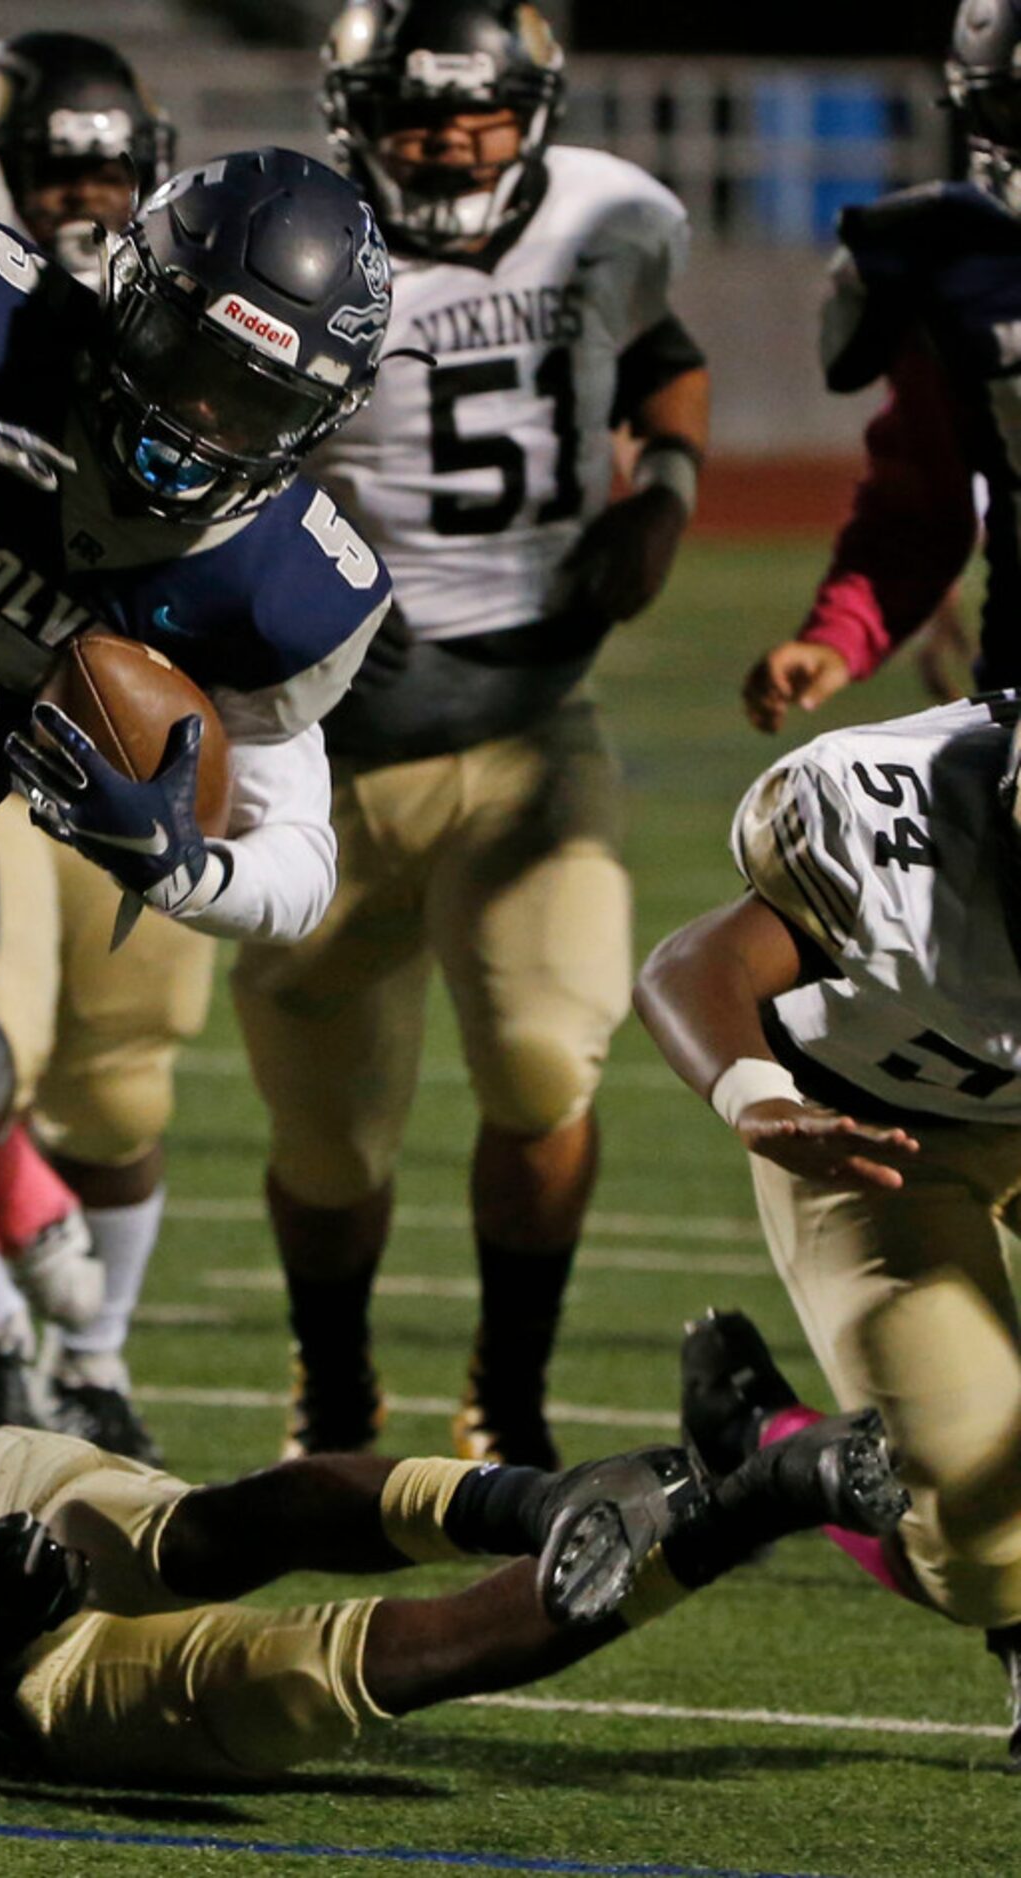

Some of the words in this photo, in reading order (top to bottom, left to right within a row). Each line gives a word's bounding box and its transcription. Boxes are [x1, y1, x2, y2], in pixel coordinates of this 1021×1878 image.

[224, 300, 293, 349] Riddell
[412, 285, 582, 353] VIKINGS
[428, 347, 584, 536] 51
[301, 488, 379, 589] 5
[851, 761, 941, 874] 54
